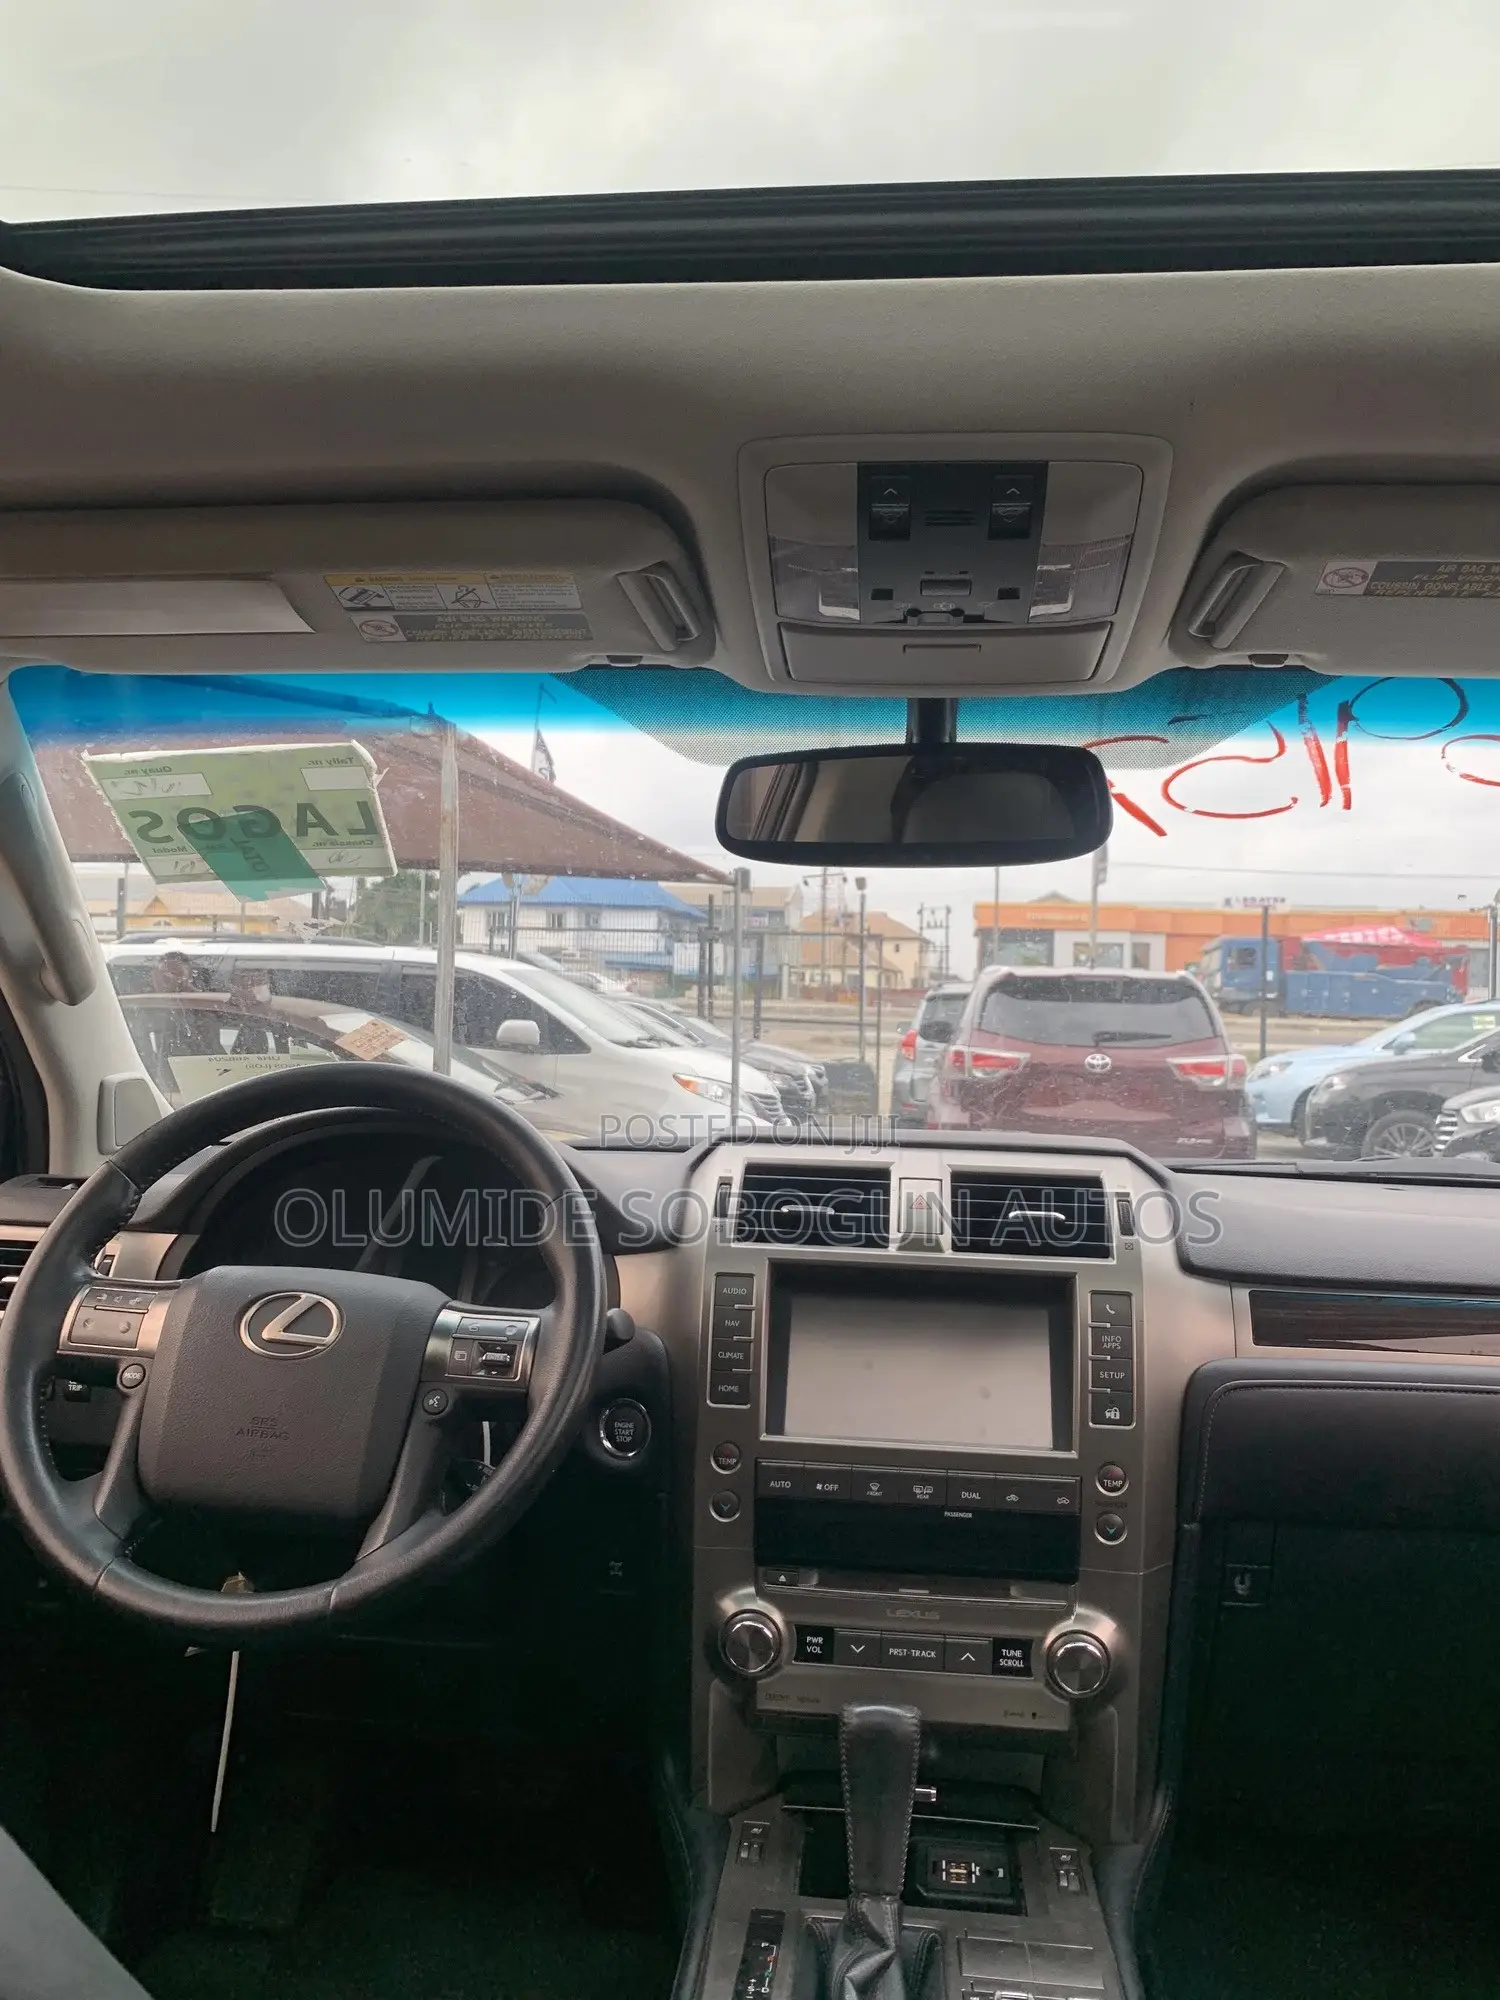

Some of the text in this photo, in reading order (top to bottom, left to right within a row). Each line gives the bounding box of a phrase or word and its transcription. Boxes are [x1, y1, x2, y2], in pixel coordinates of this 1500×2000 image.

[722, 1287, 748, 1295] AUDIO
[724, 1319, 740, 1327] NAV
[1101, 1335, 1122, 1343] INFO
[1102, 1342, 1121, 1350] APPS
[717, 1351, 745, 1360] CLIMATE
[123, 1371, 143, 1380] MODE
[1099, 1371, 1126, 1379] SETUP
[68, 1384, 83, 1392] TRIP
[718, 1385, 739, 1393] HOME
[614, 1421, 635, 1429] ENGINE
[235, 1427, 292, 1441] AIRBAG
[615, 1435, 633, 1443] STOP
[718, 1457, 737, 1465] TEMP
[769, 1480, 792, 1489] AUTO
[823, 1483, 840, 1492] OFF
[1103, 1479, 1124, 1488] TEMP
[961, 1491, 981, 1499] DUAL
[943, 1511, 973, 1519] PASSENGER
[885, 1608, 941, 1620] LEXUS
[806, 1635, 824, 1645] PWR
[805, 1645, 823, 1654] VOL
[1001, 1648, 1023, 1658] TUNE
[999, 1658, 1024, 1668] SCROLL
